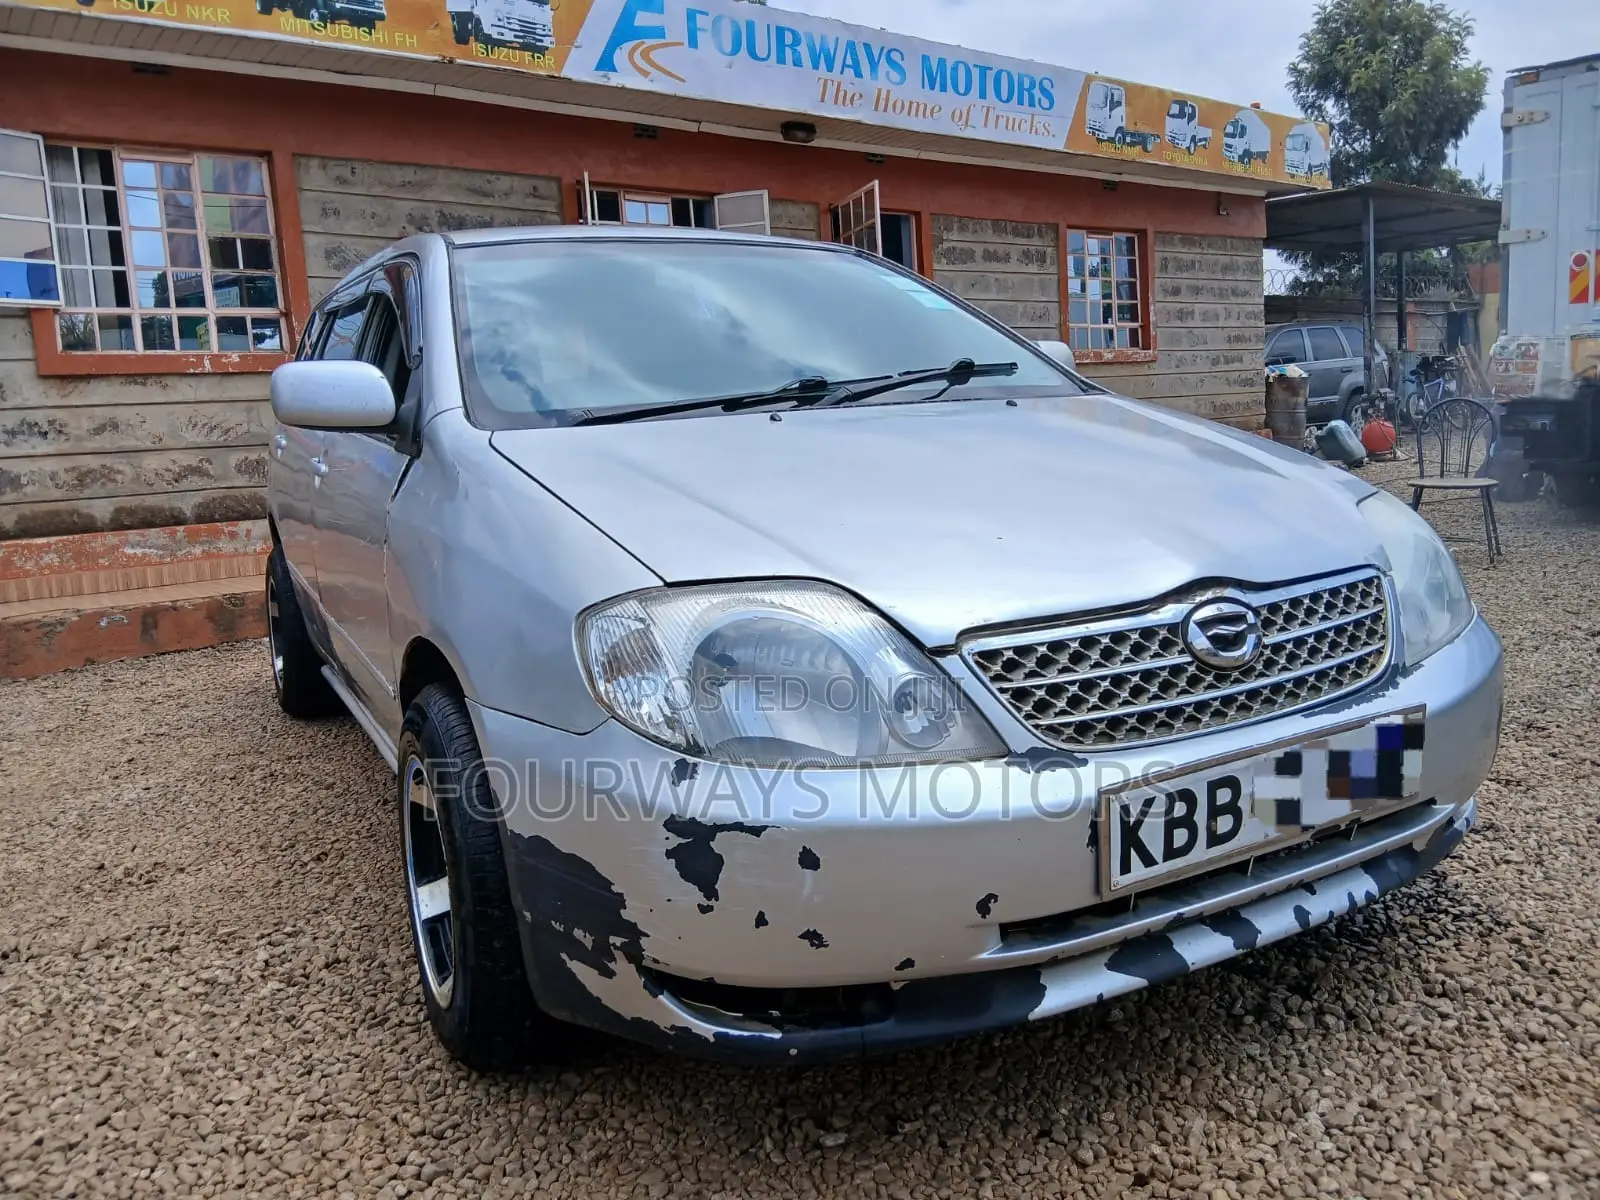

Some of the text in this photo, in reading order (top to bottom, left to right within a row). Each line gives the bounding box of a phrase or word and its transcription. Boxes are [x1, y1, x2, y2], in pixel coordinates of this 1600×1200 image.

[186, 3, 231, 24] NKR
[279, 16, 418, 48] MITSUBISHI FH
[471, 42, 556, 69] ISUZU FRR
[686, 7, 1055, 111] FOURWAYS MOTORS
[817, 76, 1057, 139] The Home of Trucks.
[1161, 150, 1189, 164] TOYOTA
[1118, 774, 1244, 876] KBB
